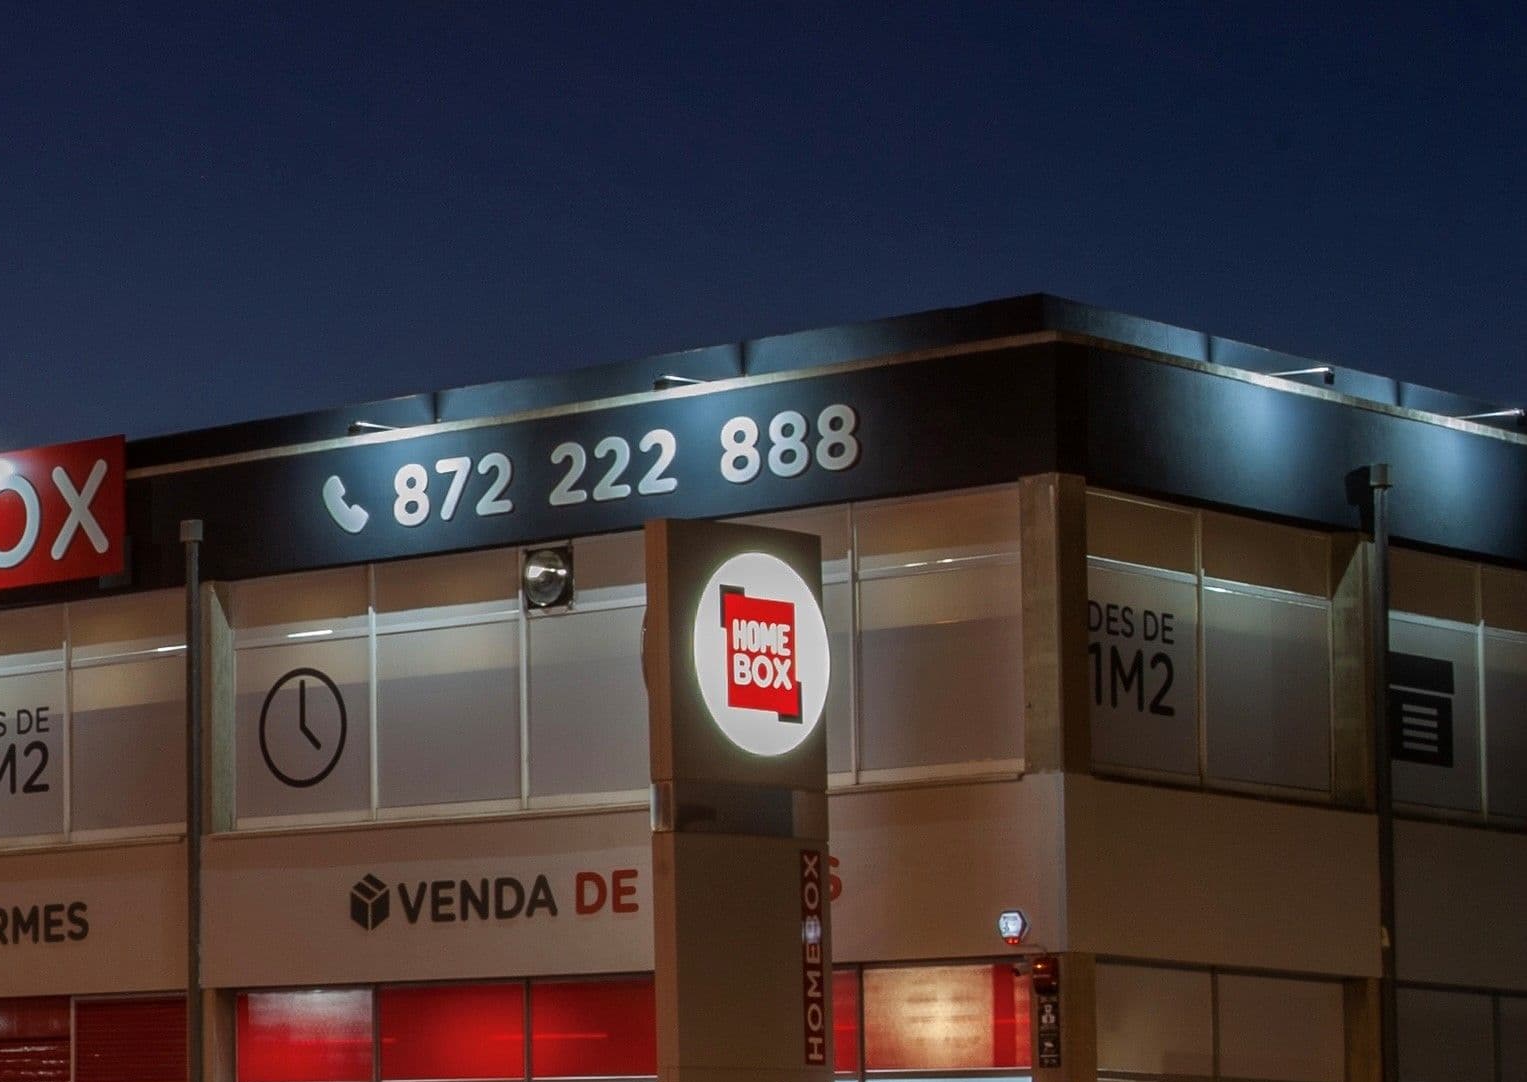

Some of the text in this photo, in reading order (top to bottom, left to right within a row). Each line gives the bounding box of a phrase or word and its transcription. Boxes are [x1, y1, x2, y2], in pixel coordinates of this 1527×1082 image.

[393, 404, 860, 527] 872 222 888
[731, 618, 792, 658] HOME
[1087, 600, 1175, 645] DES DE
[733, 653, 793, 691] BOX
[1087, 641, 1175, 717] 1M2
[17, 706, 50, 735] DE
[397, 869, 640, 924] VENDA DE
